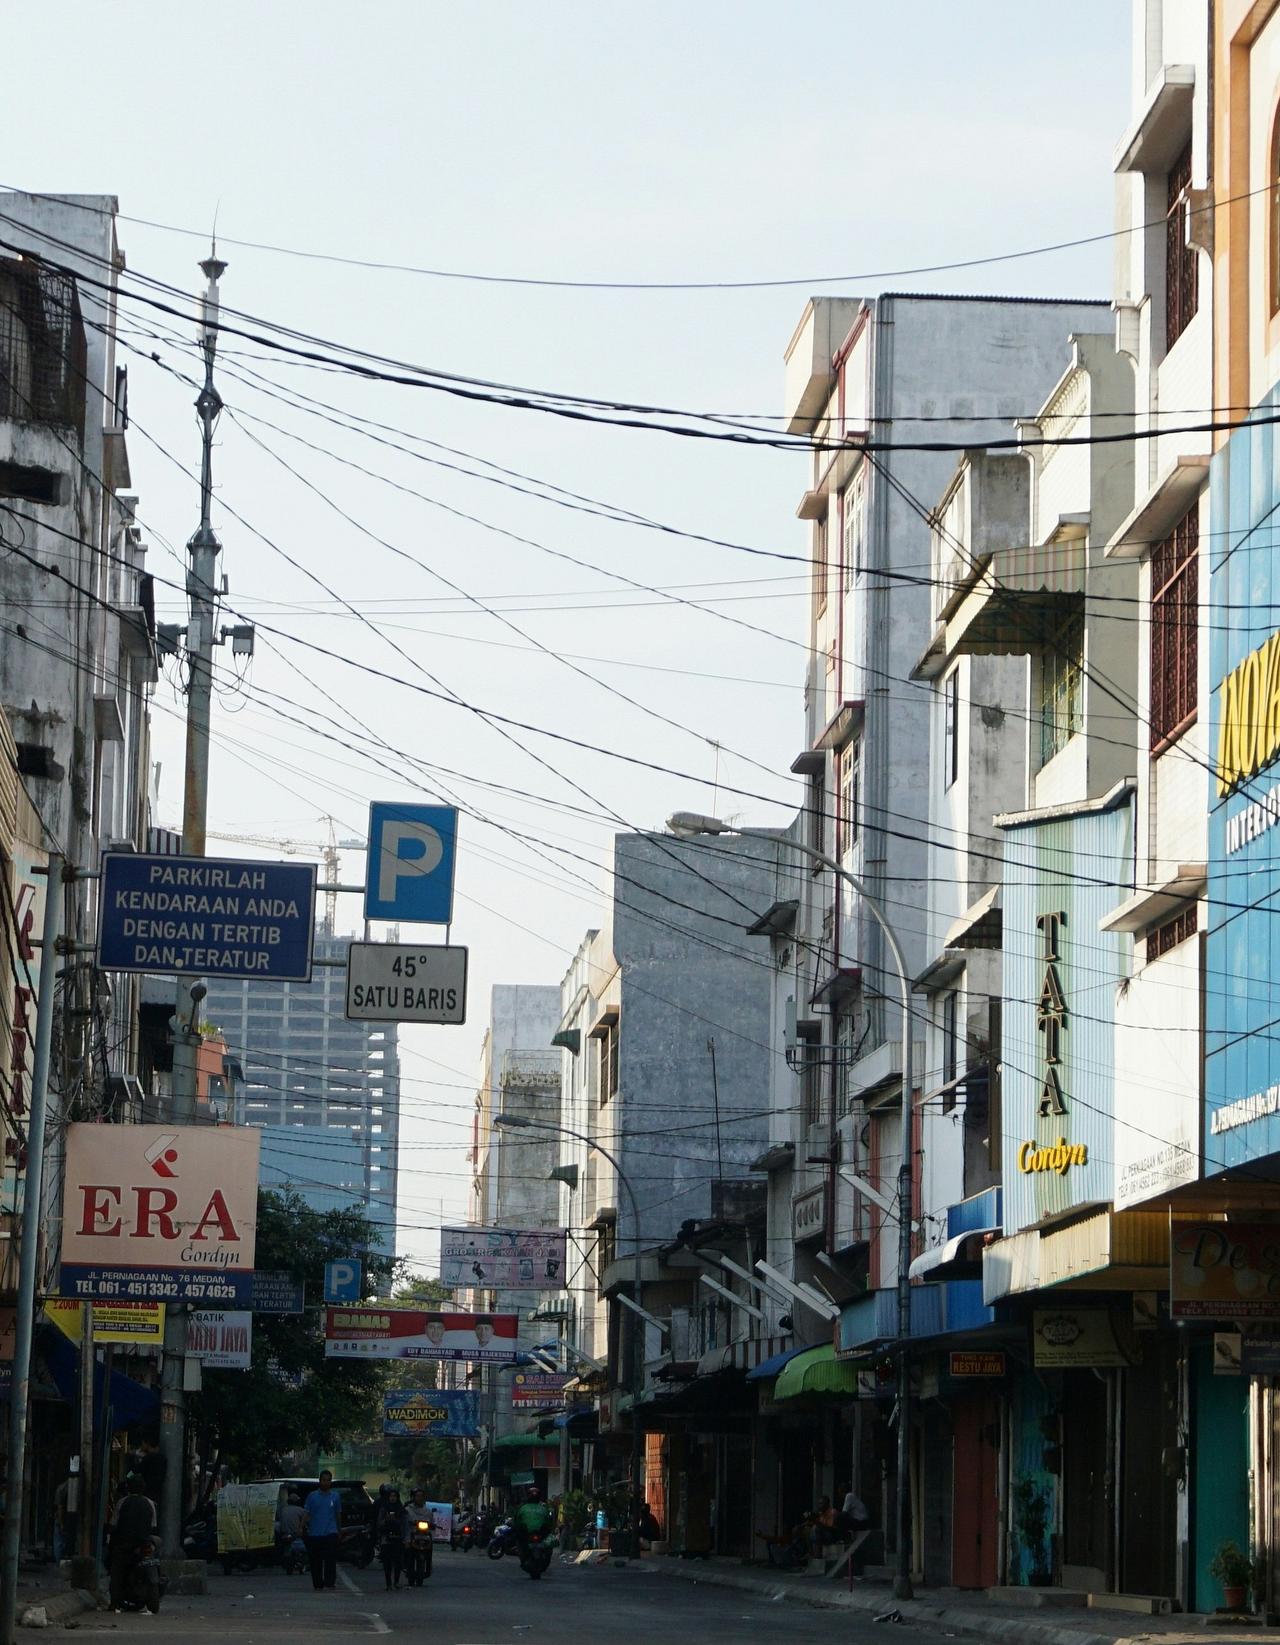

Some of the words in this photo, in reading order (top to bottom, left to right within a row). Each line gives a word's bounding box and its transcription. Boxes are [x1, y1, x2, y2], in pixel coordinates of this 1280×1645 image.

[378, 820, 443, 902] P
[149, 865, 266, 890] PARKIRLAH
[115, 890, 239, 915] KENDARAAN
[244, 897, 299, 918] ANDA
[123, 918, 205, 940] DENGAN
[211, 923, 280, 945] TERTIB
[135, 944, 176, 964] DAN
[181, 947, 270, 970] TERATUR
[353, 984, 399, 1008] SATU
[404, 987, 458, 1010] BARIS
[1035, 911, 1067, 1116] TATA
[1017, 1136, 1088, 1175] Gordyn
[75, 1185, 241, 1241] ERA
[180, 1242, 240, 1270] Gordyn
[76, 1280, 97, 1293] TEL.
[99, 1281, 120, 1294] 061
[102, 1272, 159, 1281] PERNIAGAAN
[193, 1275, 225, 1284] MEDAN
[331, 1264, 354, 1295] P
[197, 1313, 225, 1322] BATIK
[388, 1408, 446, 1420] WADIMOR
